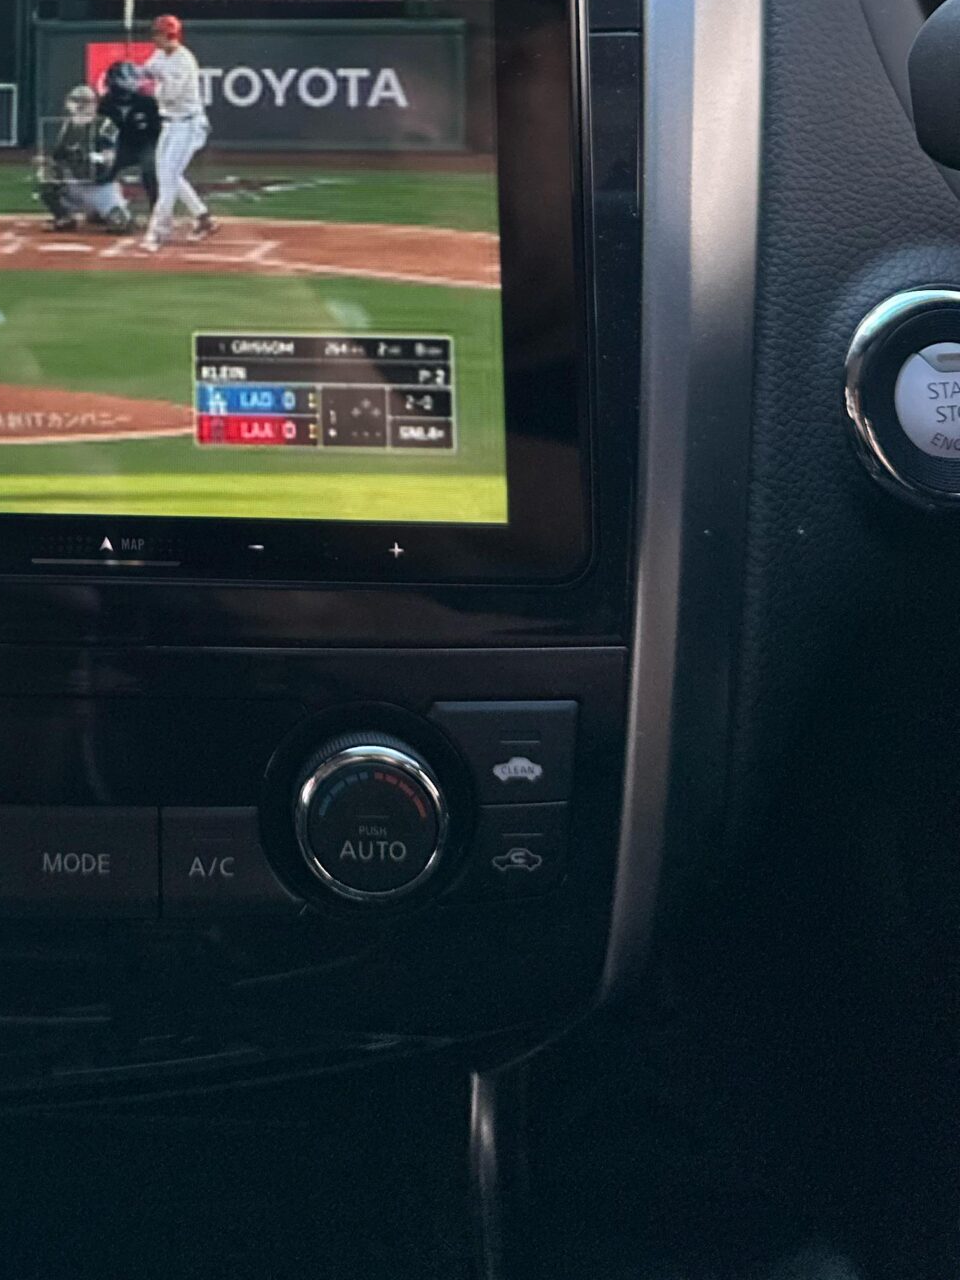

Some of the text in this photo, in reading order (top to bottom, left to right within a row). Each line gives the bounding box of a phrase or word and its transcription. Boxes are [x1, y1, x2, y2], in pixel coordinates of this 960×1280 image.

[198, 67, 409, 107] TOYOTA
[936, 405, 960, 423] ST
[121, 537, 145, 551] MAP
[500, 764, 535, 776] CLEAN
[358, 824, 388, 837] PUSH
[339, 841, 407, 863] AUTO
[42, 852, 111, 874] MODE
[188, 856, 235, 877] A/C
